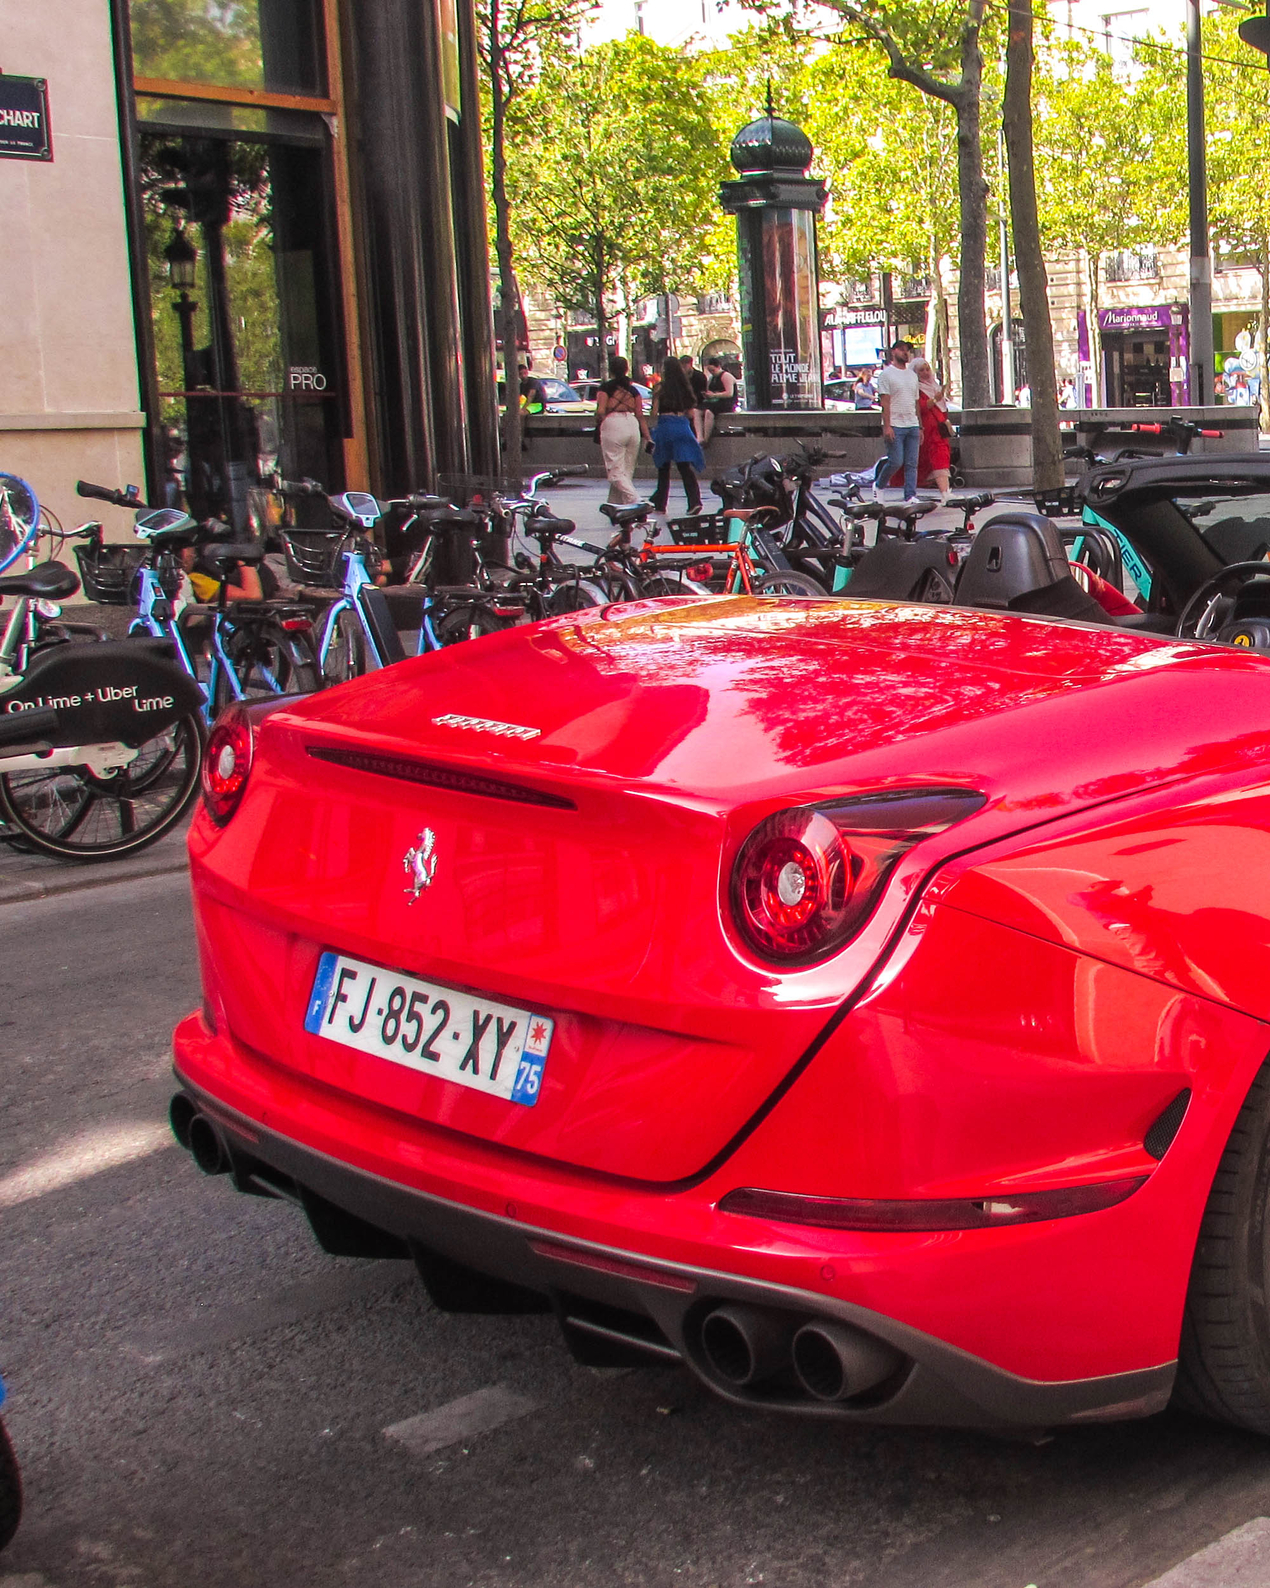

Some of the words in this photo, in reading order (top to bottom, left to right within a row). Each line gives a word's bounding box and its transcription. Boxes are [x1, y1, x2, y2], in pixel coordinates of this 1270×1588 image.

[1103, 311, 1158, 326] Marionnaud
[770, 354, 796, 363] TOUT
[783, 363, 810, 372] MONDE
[290, 374, 327, 390] PRO
[771, 373, 798, 382] AIME
[1114, 528, 1142, 581] TIER
[97, 685, 139, 702] Uber
[134, 696, 175, 712] Lime
[312, 1000, 322, 1016] F
[328, 967, 518, 1082] FJ-852-XY
[515, 1061, 542, 1094] 75
